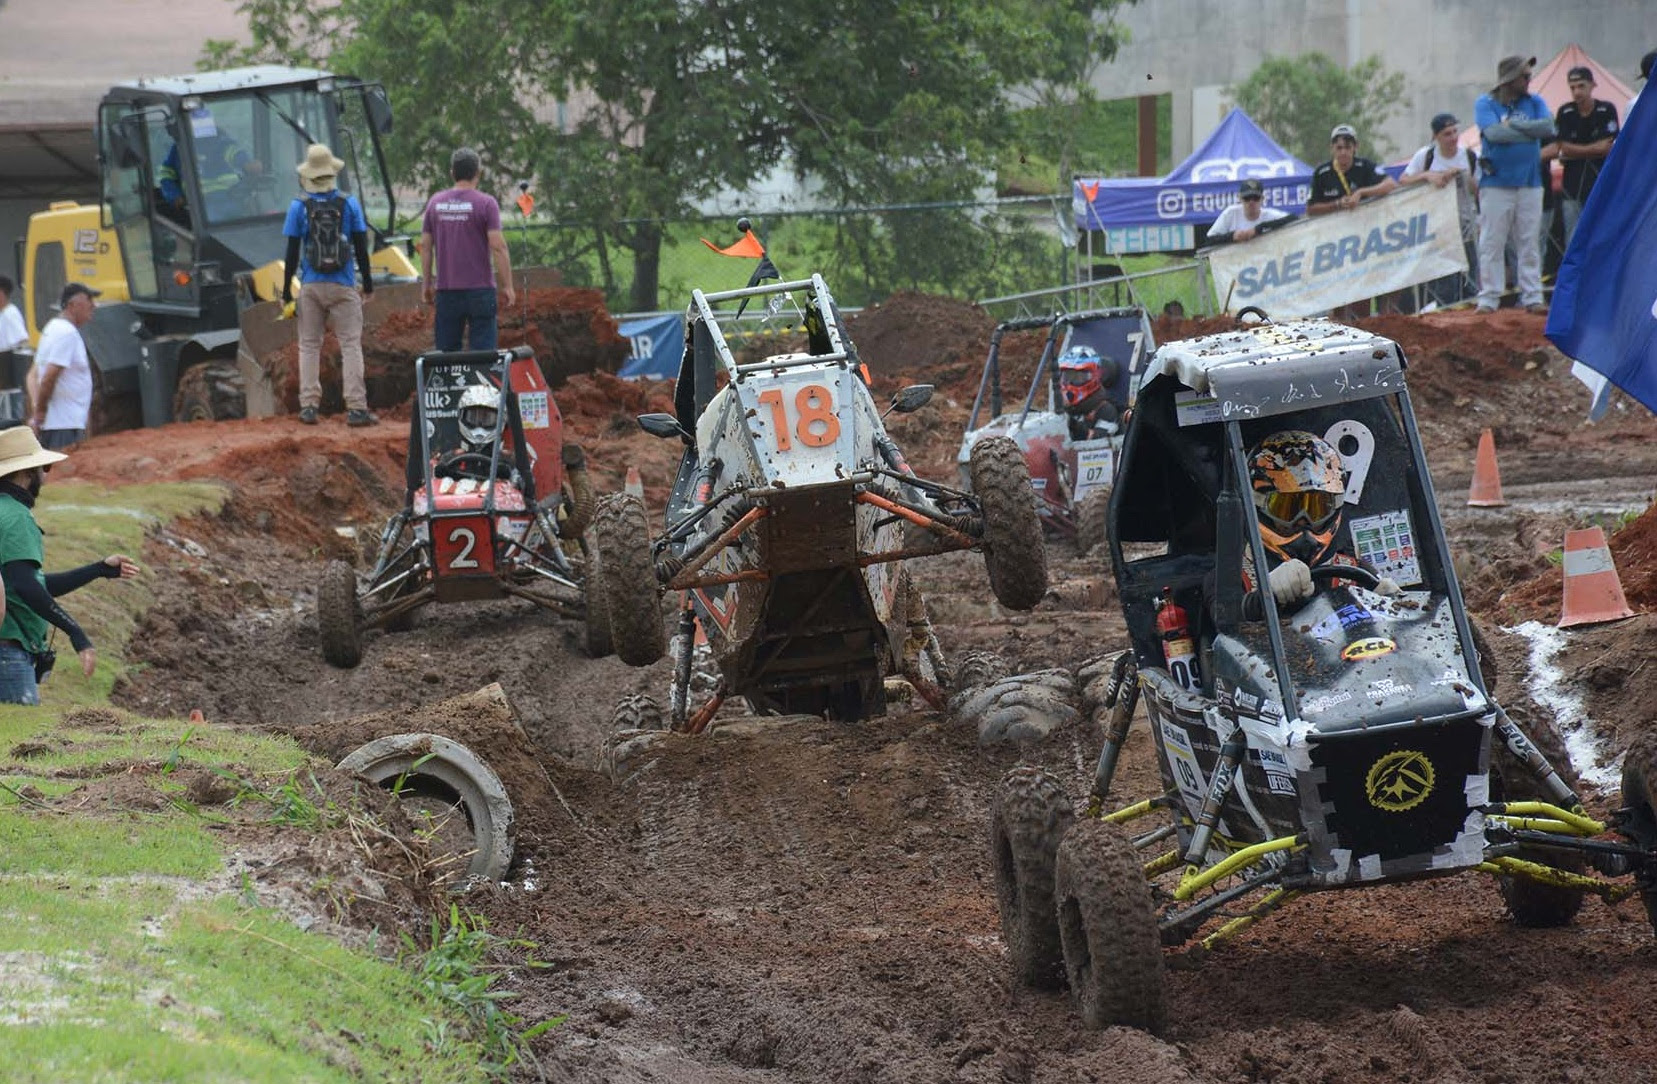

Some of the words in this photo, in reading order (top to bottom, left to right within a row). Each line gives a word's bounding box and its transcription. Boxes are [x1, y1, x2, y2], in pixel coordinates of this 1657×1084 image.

[1236, 250, 1305, 299] SAE
[1312, 213, 1436, 275] BRASIL
[758, 384, 841, 451] 18
[1086, 467, 1103, 481] 07
[1323, 419, 1375, 505] 9
[450, 527, 478, 568] 2
[1346, 641, 1390, 656] RCL
[1171, 658, 1202, 691] 09
[1500, 724, 1535, 760] FOX
[1177, 757, 1199, 791] 09
[1211, 762, 1238, 806] FOX
